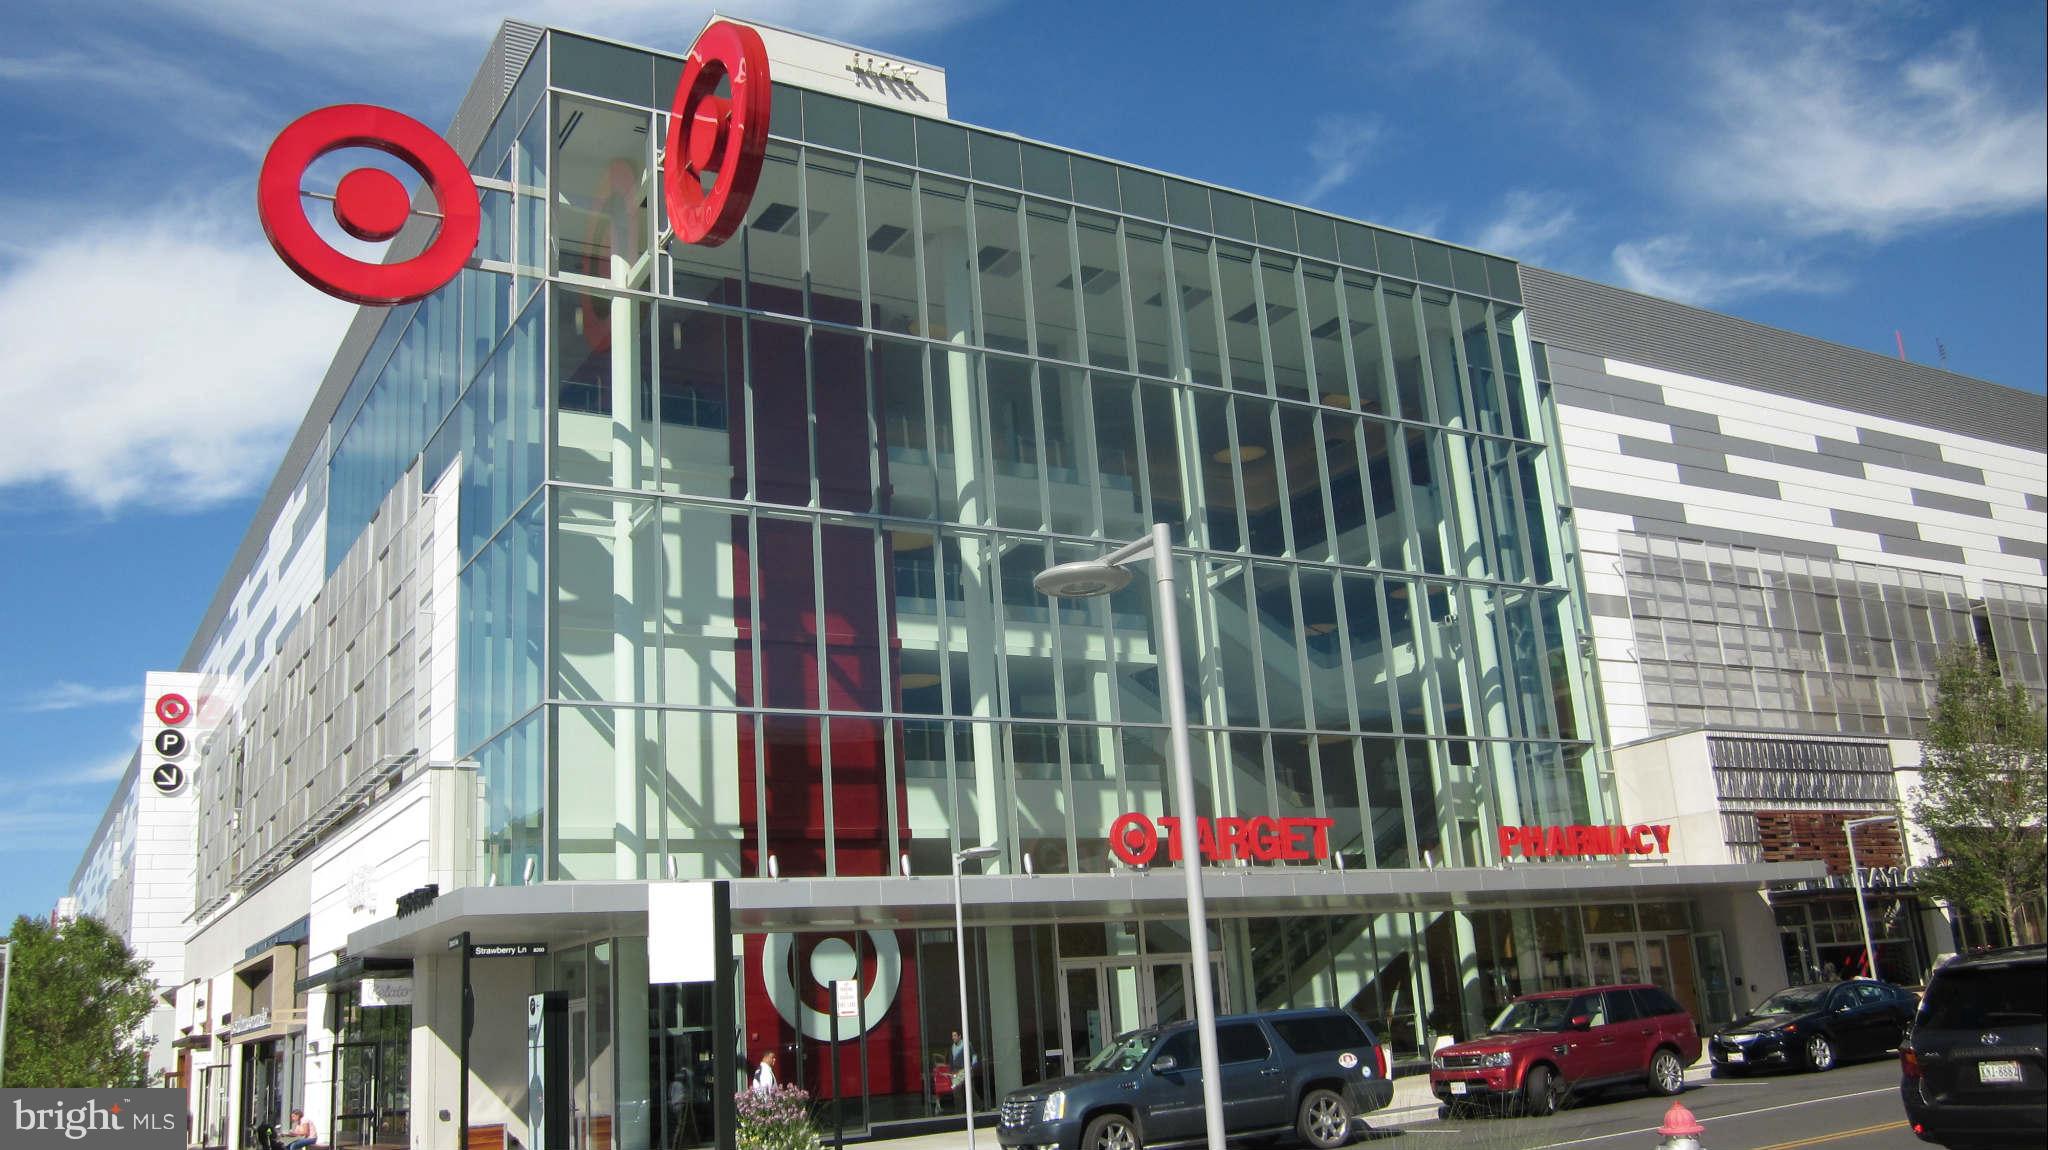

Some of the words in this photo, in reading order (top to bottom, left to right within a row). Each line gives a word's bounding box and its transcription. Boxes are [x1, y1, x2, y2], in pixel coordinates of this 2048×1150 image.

[163, 734, 179, 751] P
[1157, 816, 1335, 862] TARGET
[1499, 824, 1671, 857] PHARMACY
[475, 946, 516, 955] Strawberry
